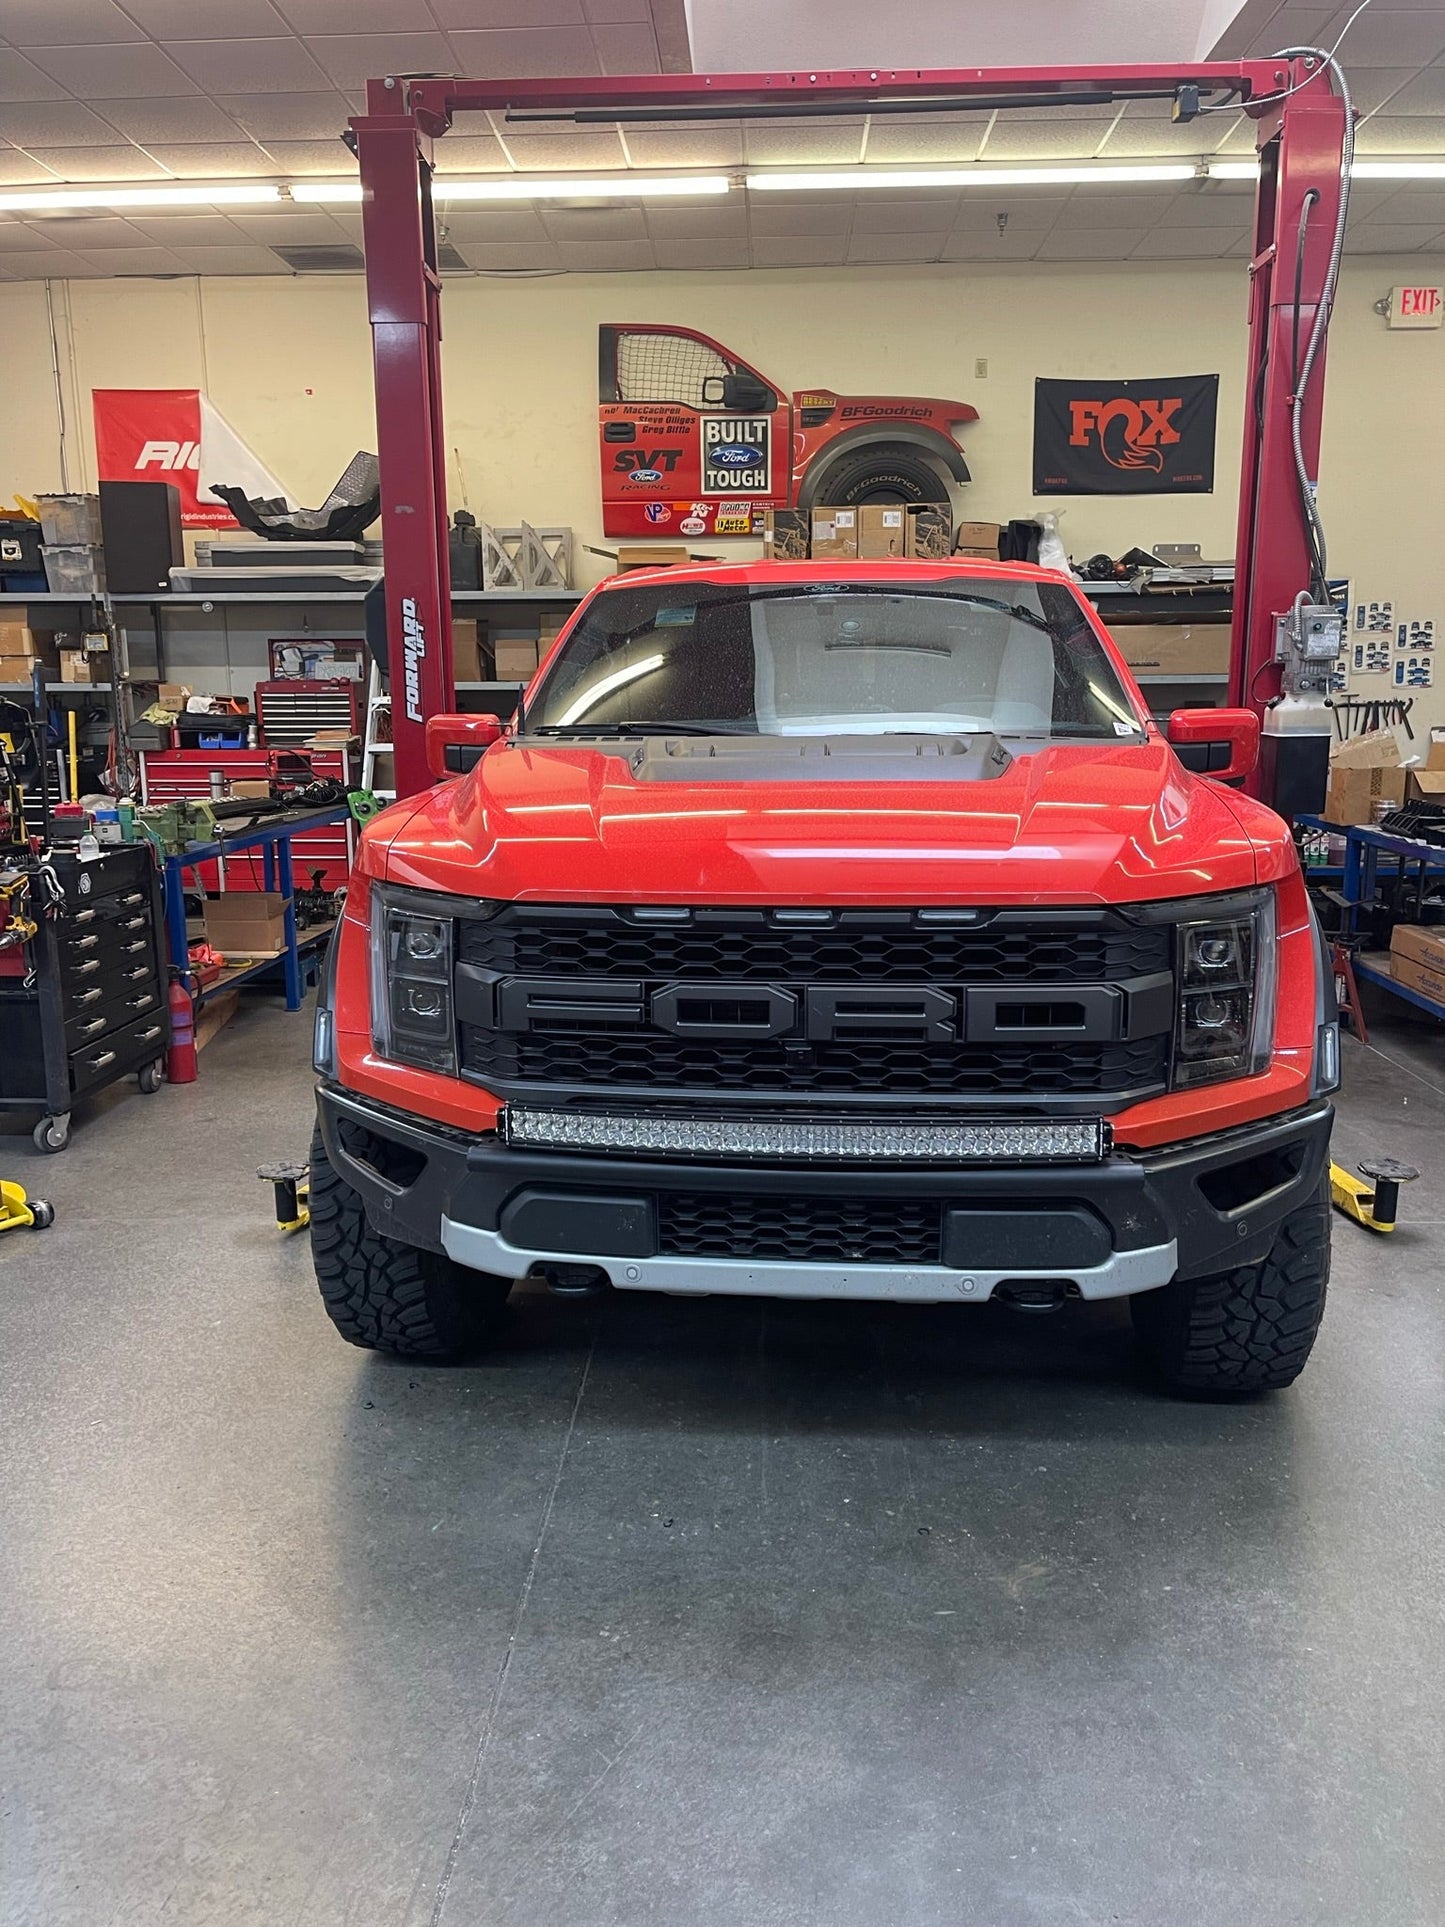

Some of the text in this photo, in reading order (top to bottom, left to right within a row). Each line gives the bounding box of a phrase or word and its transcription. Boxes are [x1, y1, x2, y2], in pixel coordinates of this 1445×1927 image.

[1402, 289, 1437, 315] EXIT
[841, 406, 933, 418] BFGoodrich
[706, 421, 767, 443] BUILT
[1069, 397, 1183, 456] FOX
[613, 449, 684, 472] SVT
[721, 449, 750, 462] Ford
[634, 471, 658, 481] Ford
[706, 469, 766, 488] TOUGH
[180, 512, 238, 521] rigidindustries.co
[402, 598, 423, 723] FORWARD
[499, 976, 1123, 1042] FORD
